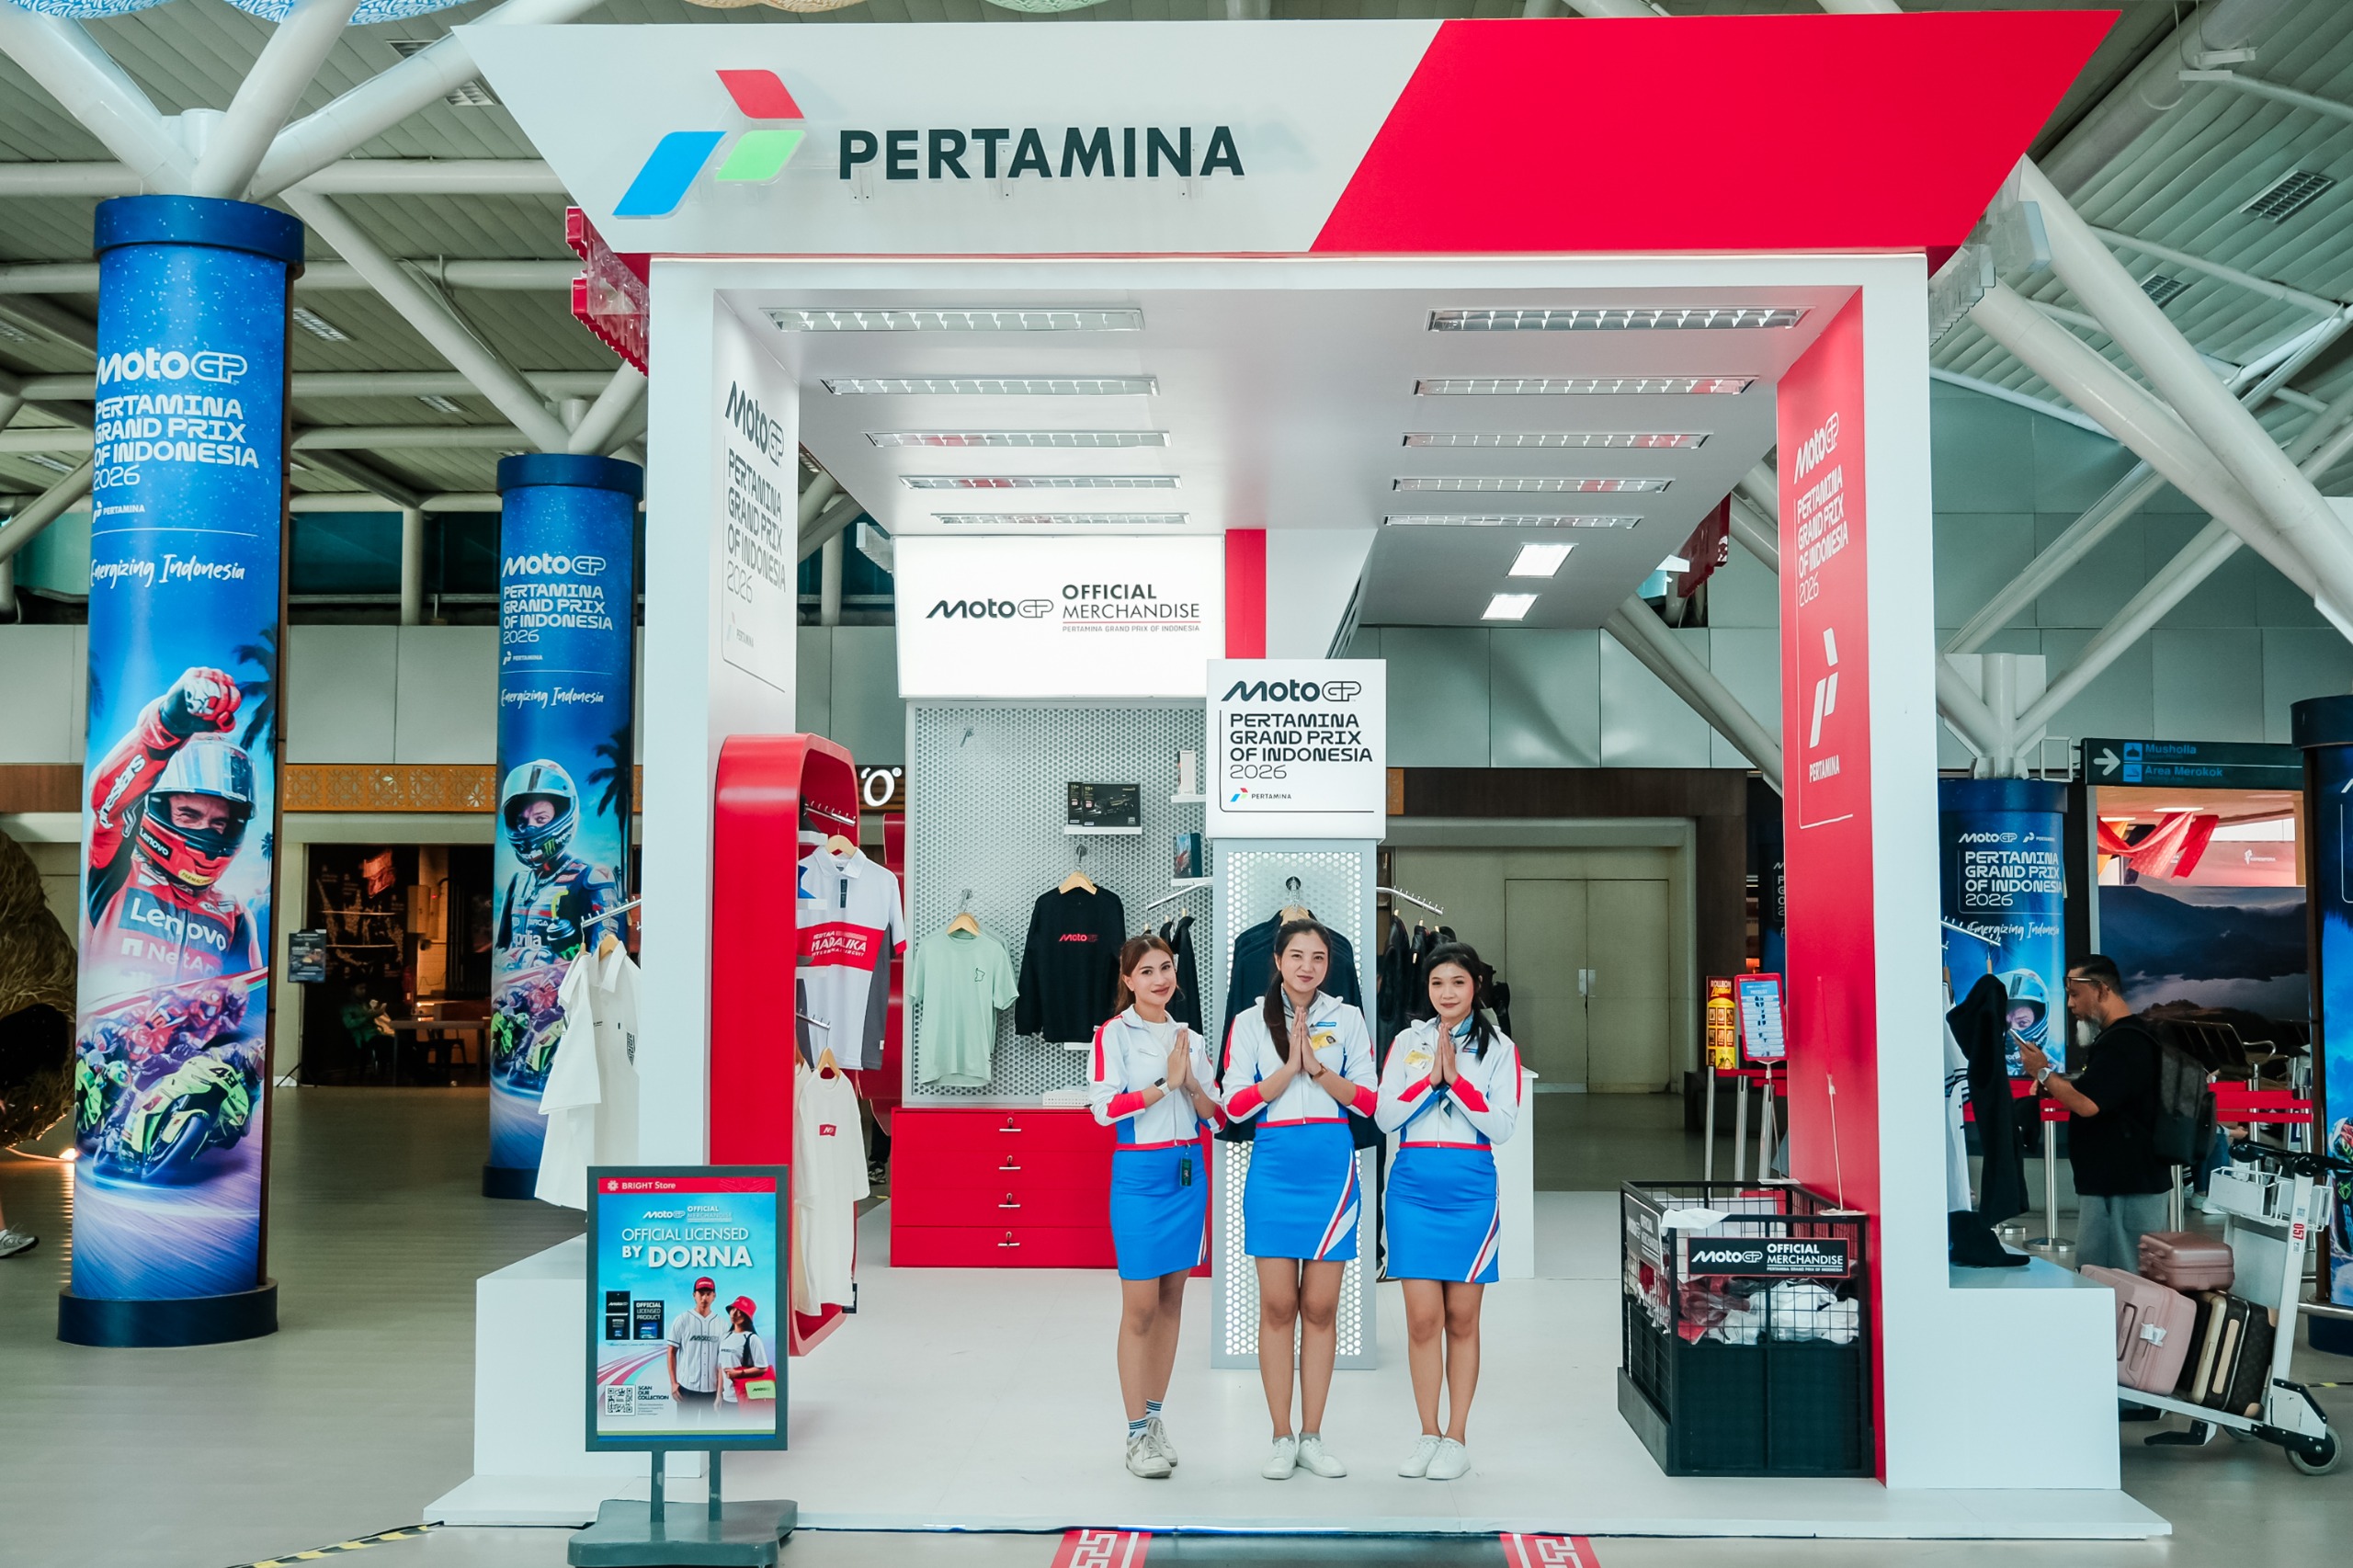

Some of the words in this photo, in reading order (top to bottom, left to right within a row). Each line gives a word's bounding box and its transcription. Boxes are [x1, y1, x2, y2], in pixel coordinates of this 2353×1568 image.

[839, 125, 1245, 181] PERTAMINA
[96, 347, 248, 389] MotoGP
[96, 394, 244, 422] PERTAMINA
[95, 417, 163, 444] GRAND
[168, 417, 247, 444] PRIX
[724, 380, 784, 468] MotoGP
[94, 445, 111, 468] OF
[113, 441, 259, 469] INDONESIA
[1793, 411, 1840, 484] MotoGP
[93, 464, 141, 491] 2026
[728, 448, 782, 522] PERTAMINA
[1797, 464, 1843, 524] PERTAMINA
[103, 504, 145, 516] PERTAMINA
[728, 485, 761, 537] GRAND
[760, 517, 783, 556] PRIX
[1798, 511, 1824, 551] GRAND
[1824, 492, 1845, 532] PRIX
[727, 522, 741, 559] OF
[741, 531, 786, 593] INDONESIA
[1798, 550, 1809, 579] OF
[1809, 520, 1848, 573] INDONESIA
[90, 558, 155, 589] Energizing
[158, 553, 245, 583] Indonesia
[502, 552, 607, 578] MotoGP
[504, 584, 604, 599] PERTAMINA
[726, 560, 753, 604] 2026
[1798, 572, 1820, 608] 2026
[1062, 584, 1157, 600] OFFICIAL
[503, 598, 553, 614] GRAND
[557, 598, 607, 615] PRIX
[925, 598, 1054, 619] MotoGP
[1063, 603, 1200, 619] MERCHANDISE
[503, 615, 518, 630] OF
[520, 613, 613, 631] INDONESIA
[503, 629, 540, 644] 2026
[500, 688, 549, 710] Energizing
[550, 687, 604, 707] Indonesia
[1221, 679, 1362, 702] MotoGP
[1230, 713, 1359, 728] PERTAMINA
[1230, 731, 1302, 744] GRAND
[1307, 731, 1362, 744] PRIX
[1230, 747, 1257, 762] OF
[1262, 747, 1373, 762] INDONESIA
[2145, 743, 2197, 755] Musholla
[1230, 765, 1287, 779] 2026
[1808, 754, 1840, 783] PERTAMINA
[2145, 765, 2171, 775] Area
[2174, 766, 2223, 777] Merokok
[139, 827, 169, 856] Lenovo
[1958, 832, 2018, 843] MotoGP
[1965, 851, 2059, 865] PERTAMINA
[1965, 865, 2026, 878] GRAND
[2029, 866, 2060, 879] PRIX
[1965, 879, 1988, 892] OF
[1992, 880, 2063, 893] INDONESIA
[1965, 893, 2013, 906] 2026
[131, 897, 226, 952] Lenovo
[1968, 921, 2025, 941] Energizing
[811, 937, 867, 953] MADALIKA
[1058, 933, 1098, 943] MotoGP
[654, 1181, 676, 1189] Store
[642, 1210, 686, 1219] MotoGP
[621, 1228, 681, 1241] OFFICIAL
[685, 1228, 749, 1241] LICENSED
[2292, 1222, 2305, 1241] 057
[621, 1246, 642, 1258] BY
[648, 1245, 753, 1268] DORNA
[1691, 1249, 1763, 1263] MotoGP
[1767, 1244, 1820, 1254] OFFICIAL
[1767, 1255, 1843, 1265] MERCHANDISE
